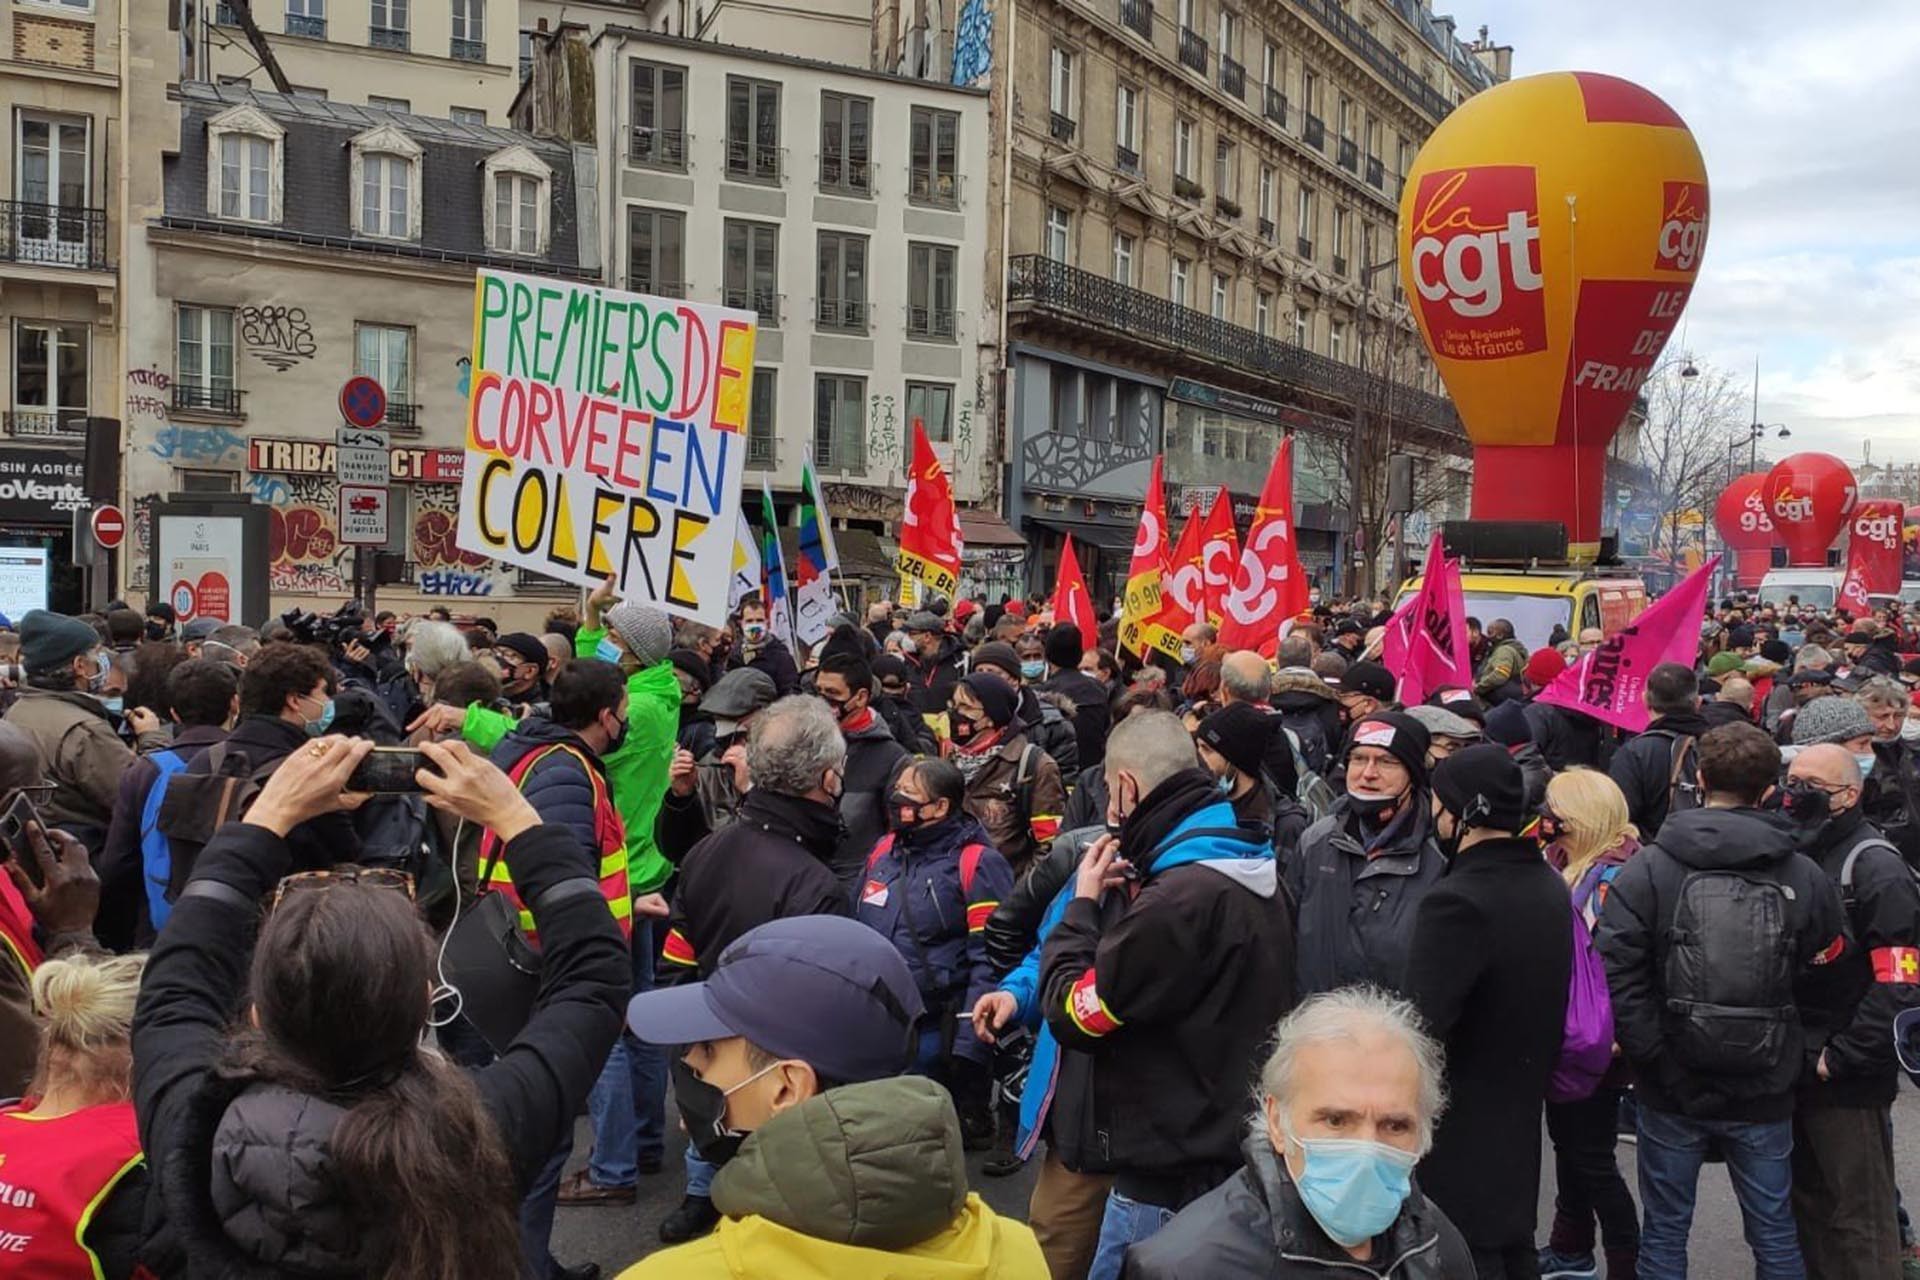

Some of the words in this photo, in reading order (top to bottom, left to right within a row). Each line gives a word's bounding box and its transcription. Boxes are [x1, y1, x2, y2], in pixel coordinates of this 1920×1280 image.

[1412, 211, 1544, 317] cgt
[1649, 291, 1682, 318] ILE
[1631, 330, 1664, 355] DE
[254, 440, 337, 473] TRIBA
[390, 450, 426, 478] CT
[341, 462, 387, 471] TRANSPORT
[646, 417, 728, 516] EN
[438, 468, 464, 477] BLAC
[1740, 511, 1774, 532] 95
[1774, 497, 1814, 522] cgt
[1855, 515, 1898, 542] cgt
